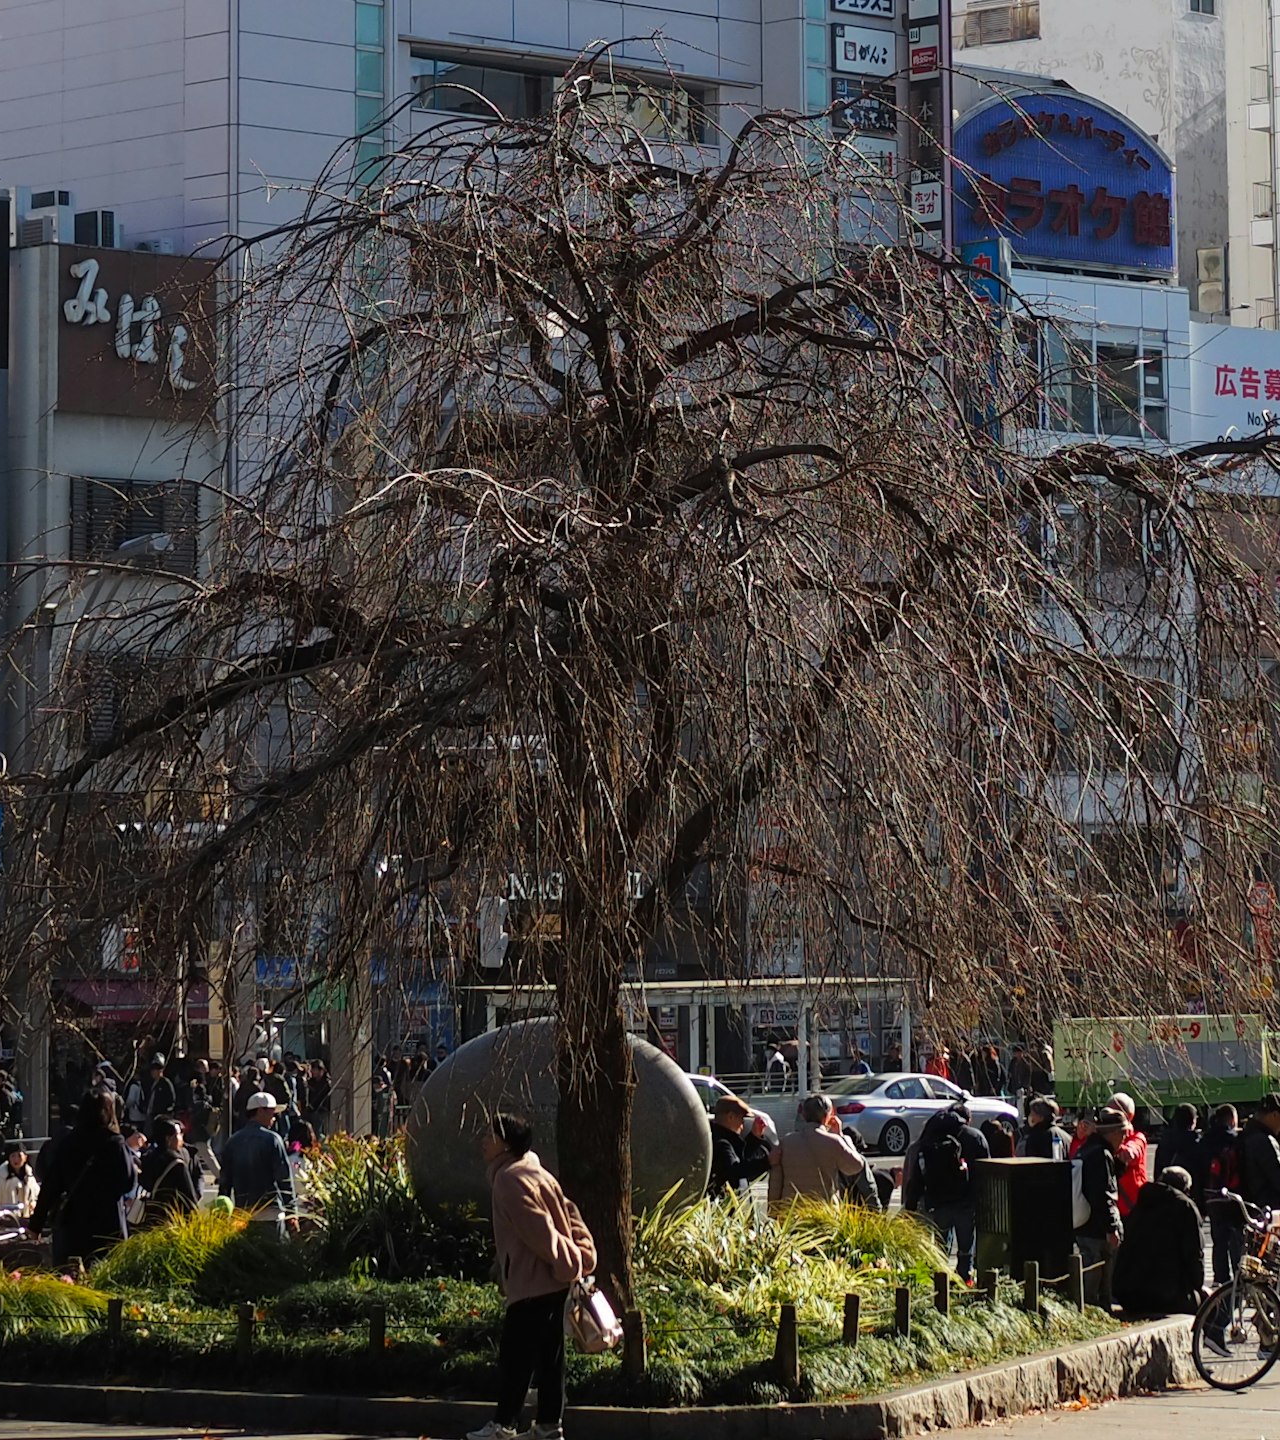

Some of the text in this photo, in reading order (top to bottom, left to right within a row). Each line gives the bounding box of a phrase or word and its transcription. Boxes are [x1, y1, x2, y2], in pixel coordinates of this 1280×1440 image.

[859, 44, 888, 64] がんこ
[915, 190, 939, 202] ホット
[918, 203, 935, 214] ヨガ
[972, 173, 1171, 247] カラオケ館
[63, 258, 200, 391] みはし
